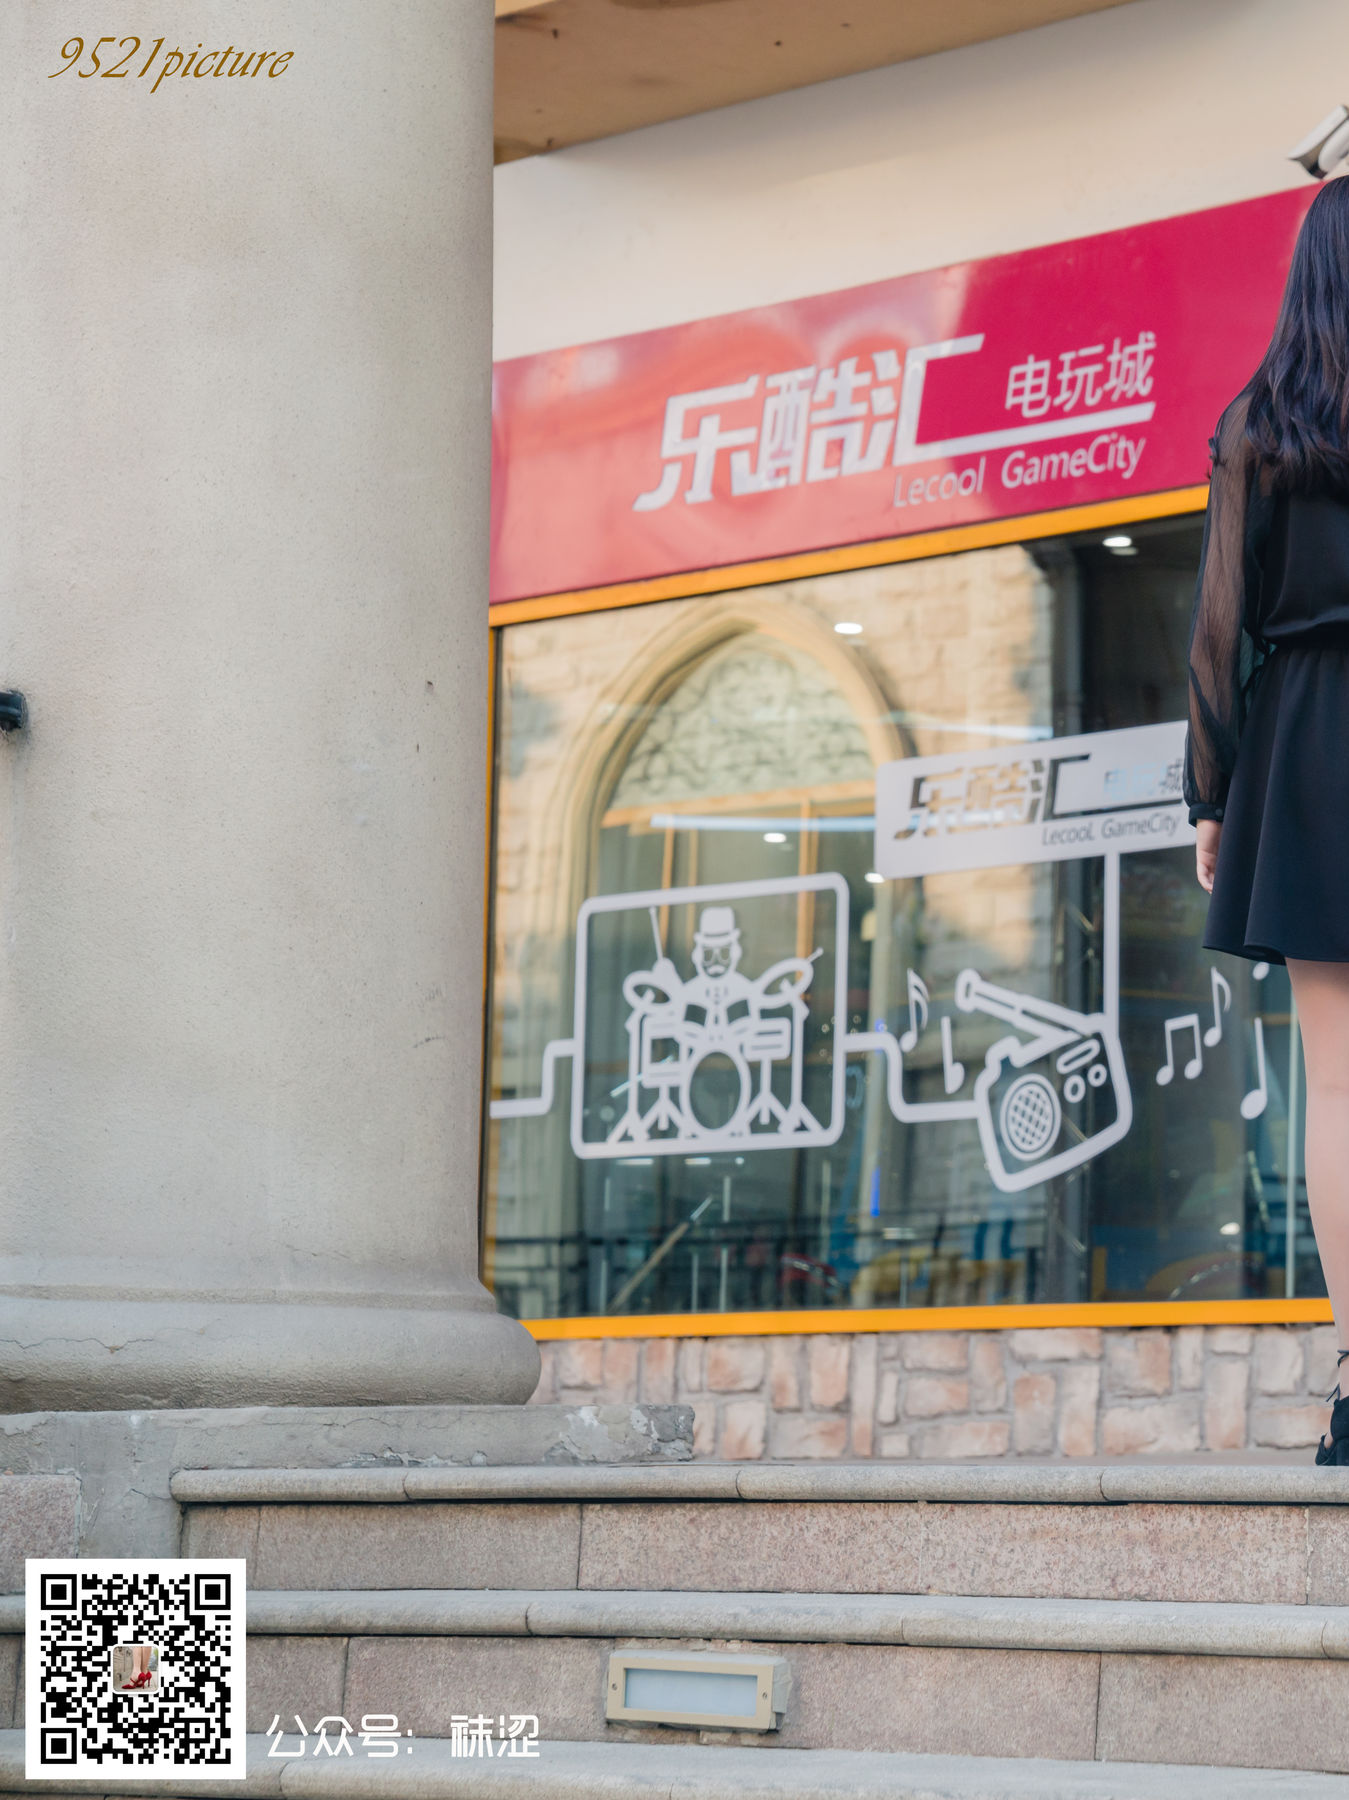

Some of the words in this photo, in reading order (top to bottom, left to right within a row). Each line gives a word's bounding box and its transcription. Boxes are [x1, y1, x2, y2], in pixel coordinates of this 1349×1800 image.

[632, 333, 1156, 512] 乐酷汇
[1004, 331, 1157, 418] 电玩城
[894, 457, 985, 508] Lecool
[1001, 432, 1147, 489] GameCity
